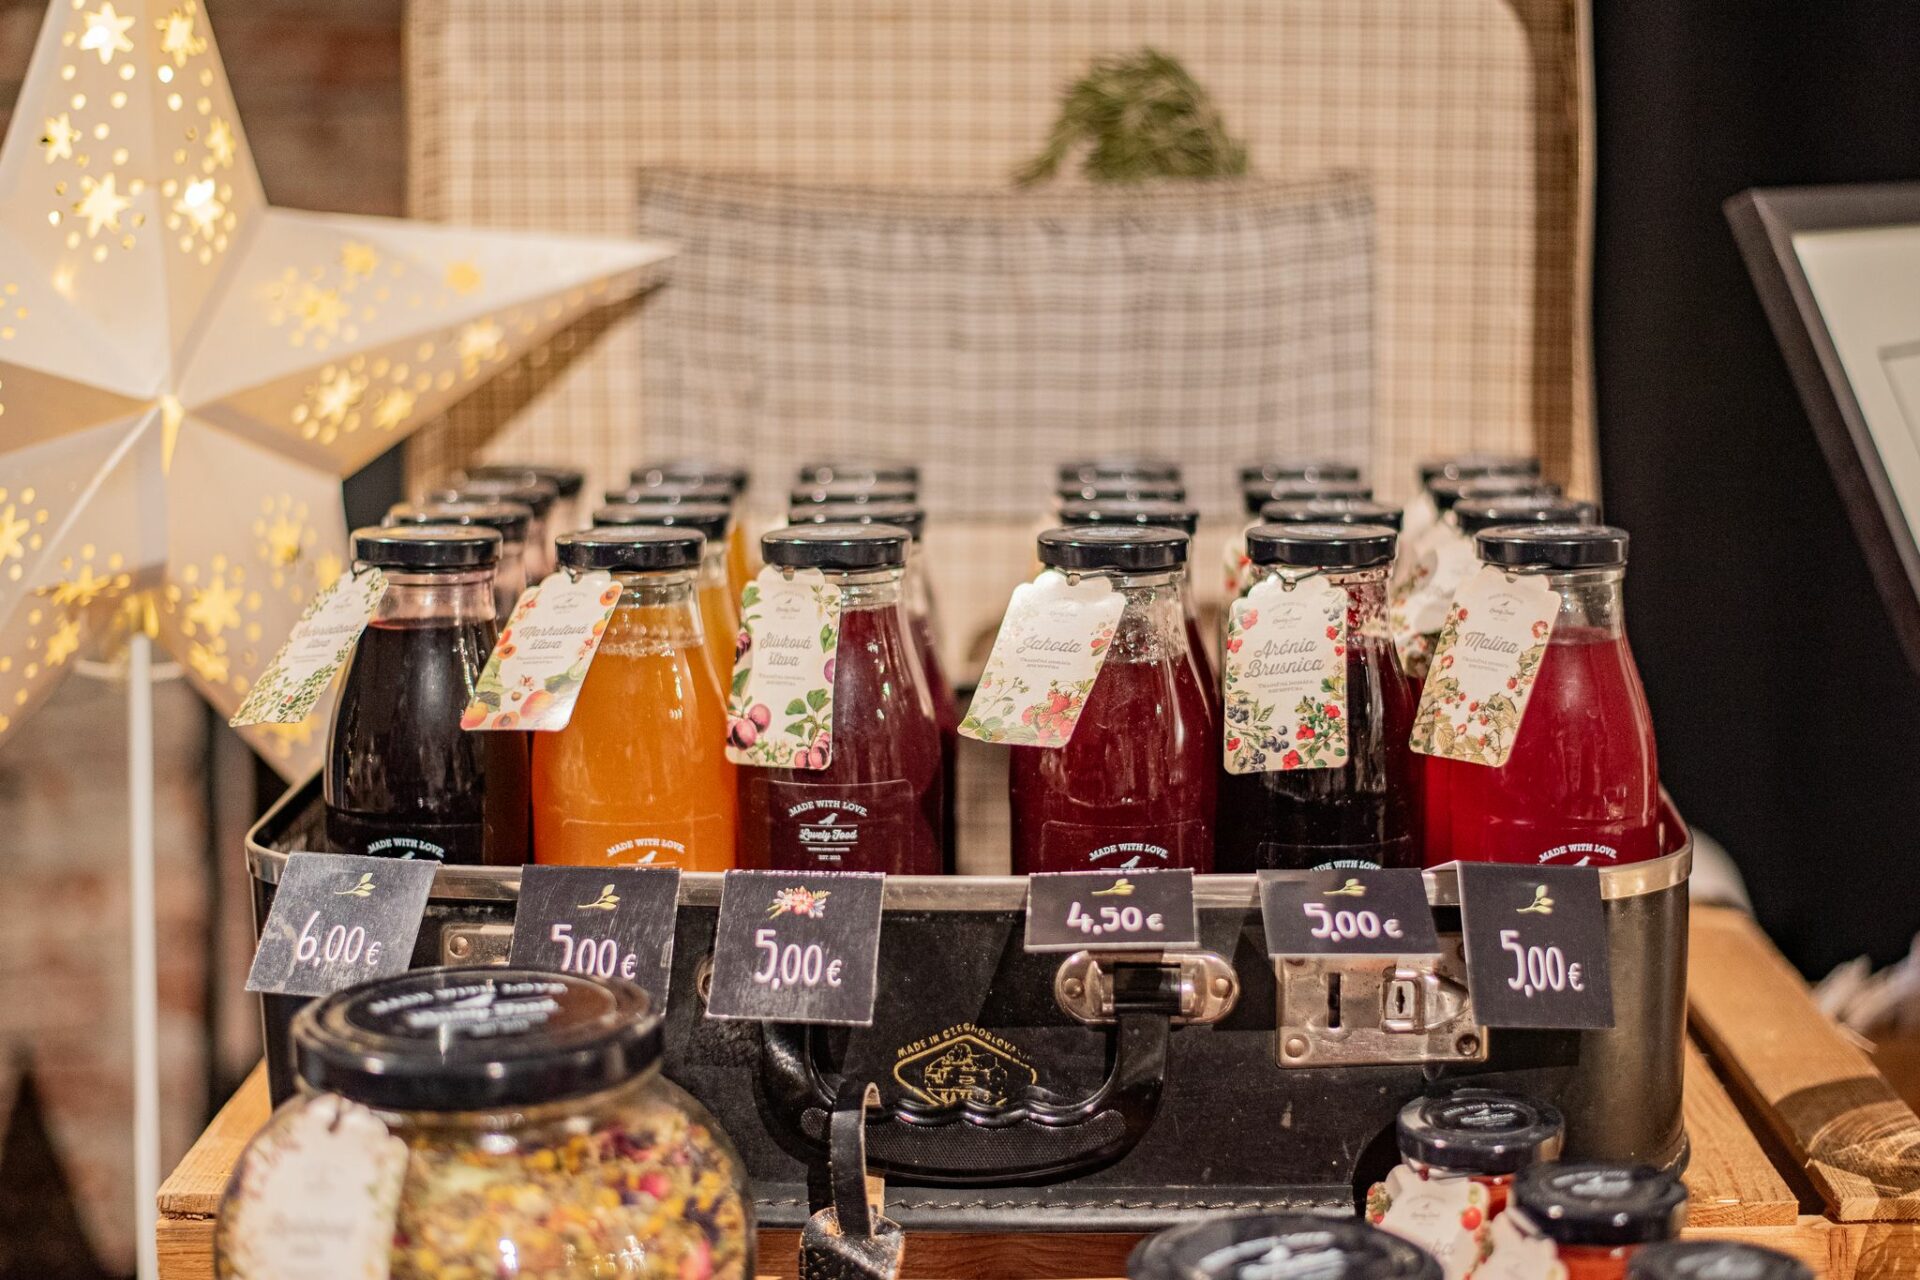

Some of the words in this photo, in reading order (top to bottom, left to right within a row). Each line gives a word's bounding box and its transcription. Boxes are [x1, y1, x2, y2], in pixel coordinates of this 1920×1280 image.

[1016, 634, 1081, 653] Jahoda
[1254, 638, 1317, 659] Arónia
[1465, 631, 1519, 654] Malina
[1244, 657, 1324, 678] Brusnica
[788, 801, 815, 817] MADE
[816, 800, 841, 809] WITH
[799, 828, 831, 842] Lovely
[832, 829, 858, 840] Food
[367, 839, 392, 854] MADE
[393, 837, 418, 848] WITH
[419, 840, 445, 858] LOVE
[1089, 844, 1117, 861] MADE
[1118, 843, 1144, 852] WITH
[1538, 845, 1567, 863] MADE
[1568, 843, 1593, 852] WITH
[1333, 860, 1358, 869] WITH
[897, 1038, 927, 1058] MADE
[929, 1033, 941, 1045] IN
[943, 1022, 1033, 1060] CZECHOSLOVA
